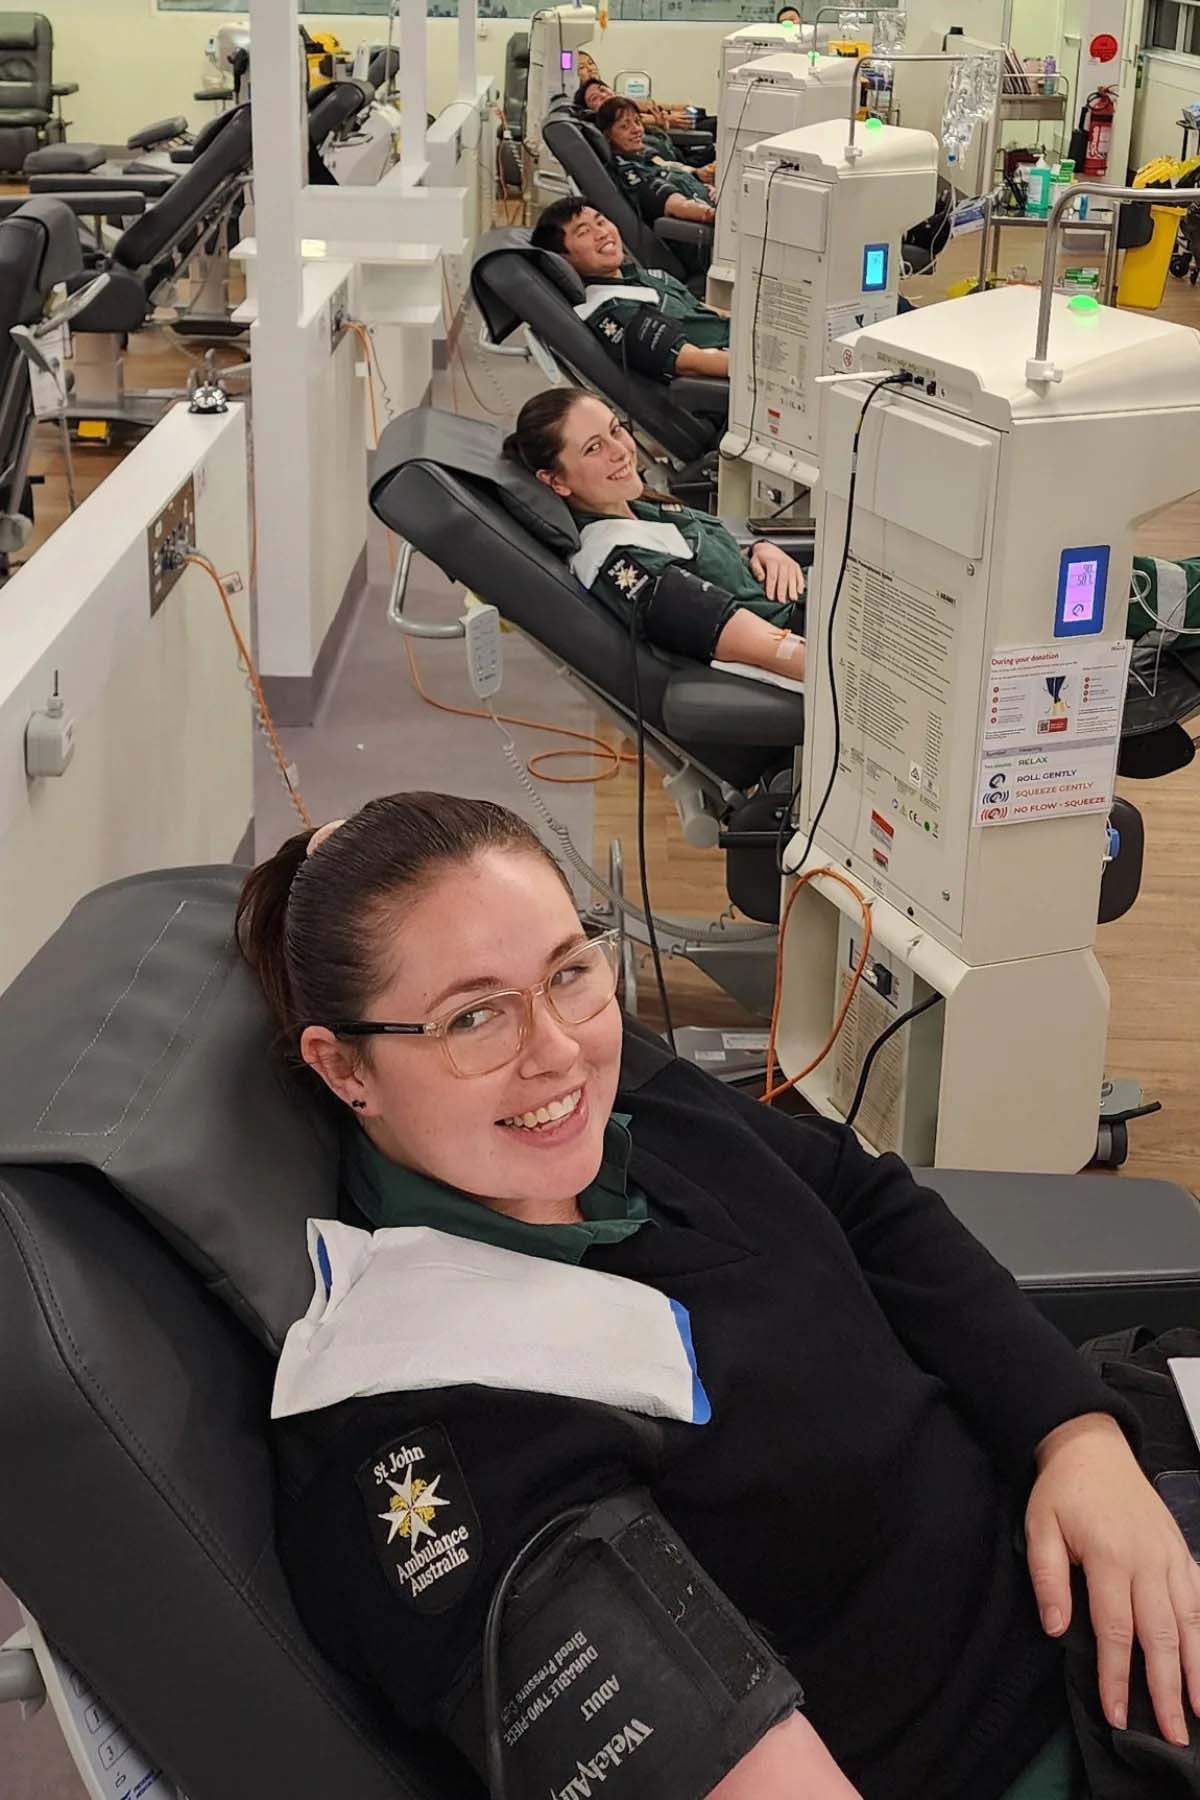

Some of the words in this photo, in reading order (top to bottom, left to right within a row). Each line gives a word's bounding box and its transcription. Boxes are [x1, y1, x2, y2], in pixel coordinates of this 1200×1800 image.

[991, 657, 1014, 666] During
[1015, 657, 1029, 665] your
[1031, 653, 1059, 661] donation
[1016, 774, 1041, 783] ROLL
[1042, 769, 1077, 780] GENTLY
[1018, 756, 1048, 766] RELAX
[1014, 805, 1028, 814] NO
[1030, 802, 1057, 811] FLOW
[1063, 796, 1105, 807] SQUEEZE
[1015, 786, 1057, 798] SQUEEZE
[1058, 782, 1094, 792] GENTLY
[373, 1461, 389, 1485] St
[388, 1446, 426, 1473] John
[396, 1525, 469, 1584] Ambulance
[410, 1546, 470, 1597] Australia
[554, 1630, 588, 1666] Blood
[515, 1659, 558, 1703] Pressure
[549, 1645, 599, 1699] DURABLE
[580, 1674, 620, 1722] ADULT
[503, 1690, 553, 1746] TWO-PIECE
